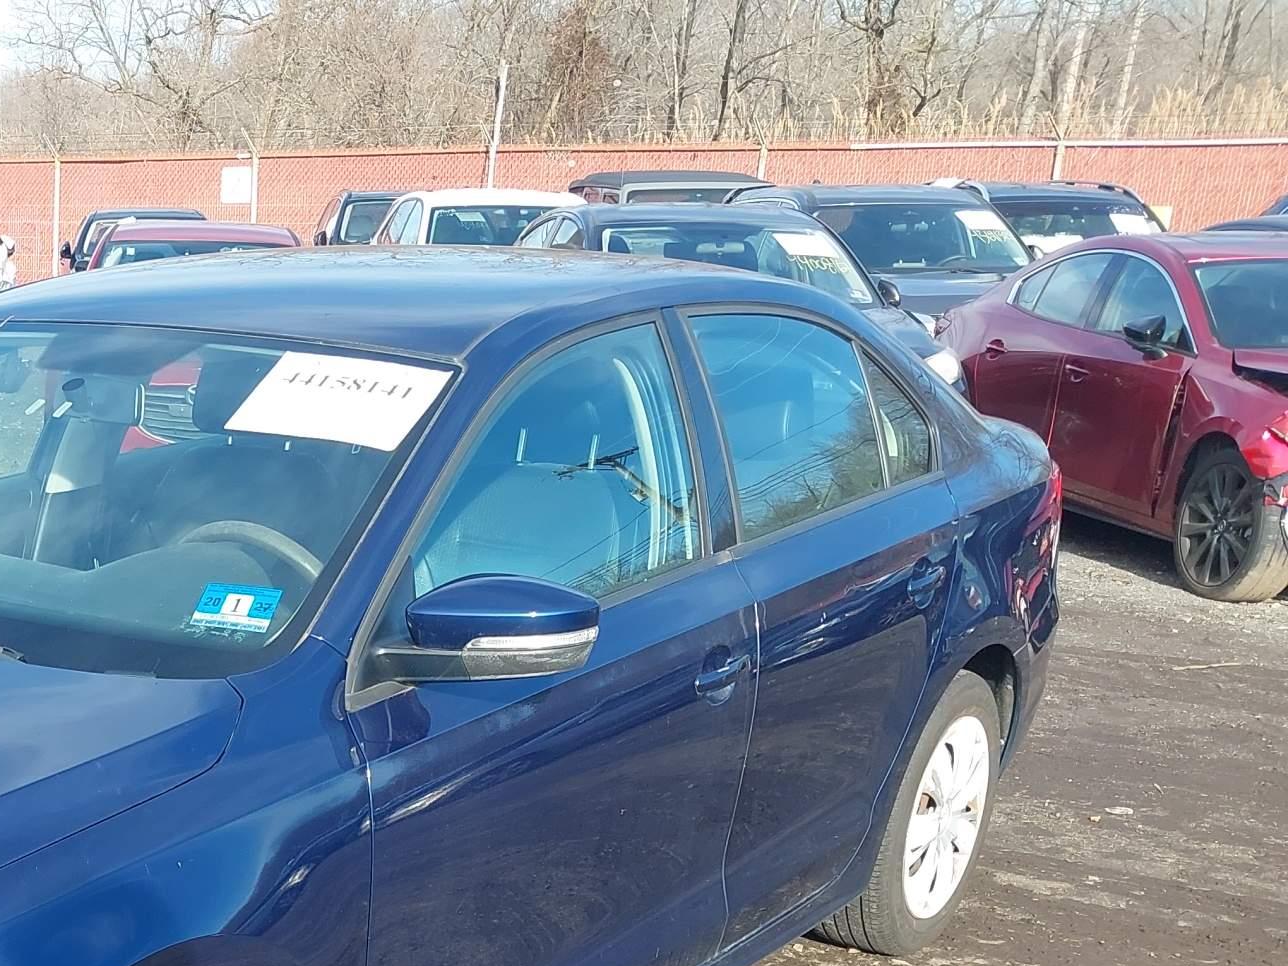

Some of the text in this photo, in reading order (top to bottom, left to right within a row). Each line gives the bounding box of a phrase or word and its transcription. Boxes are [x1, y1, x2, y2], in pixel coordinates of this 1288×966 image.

[283, 371, 413, 400] 44158141
[203, 596, 222, 608] 20
[231, 597, 243, 613] 1
